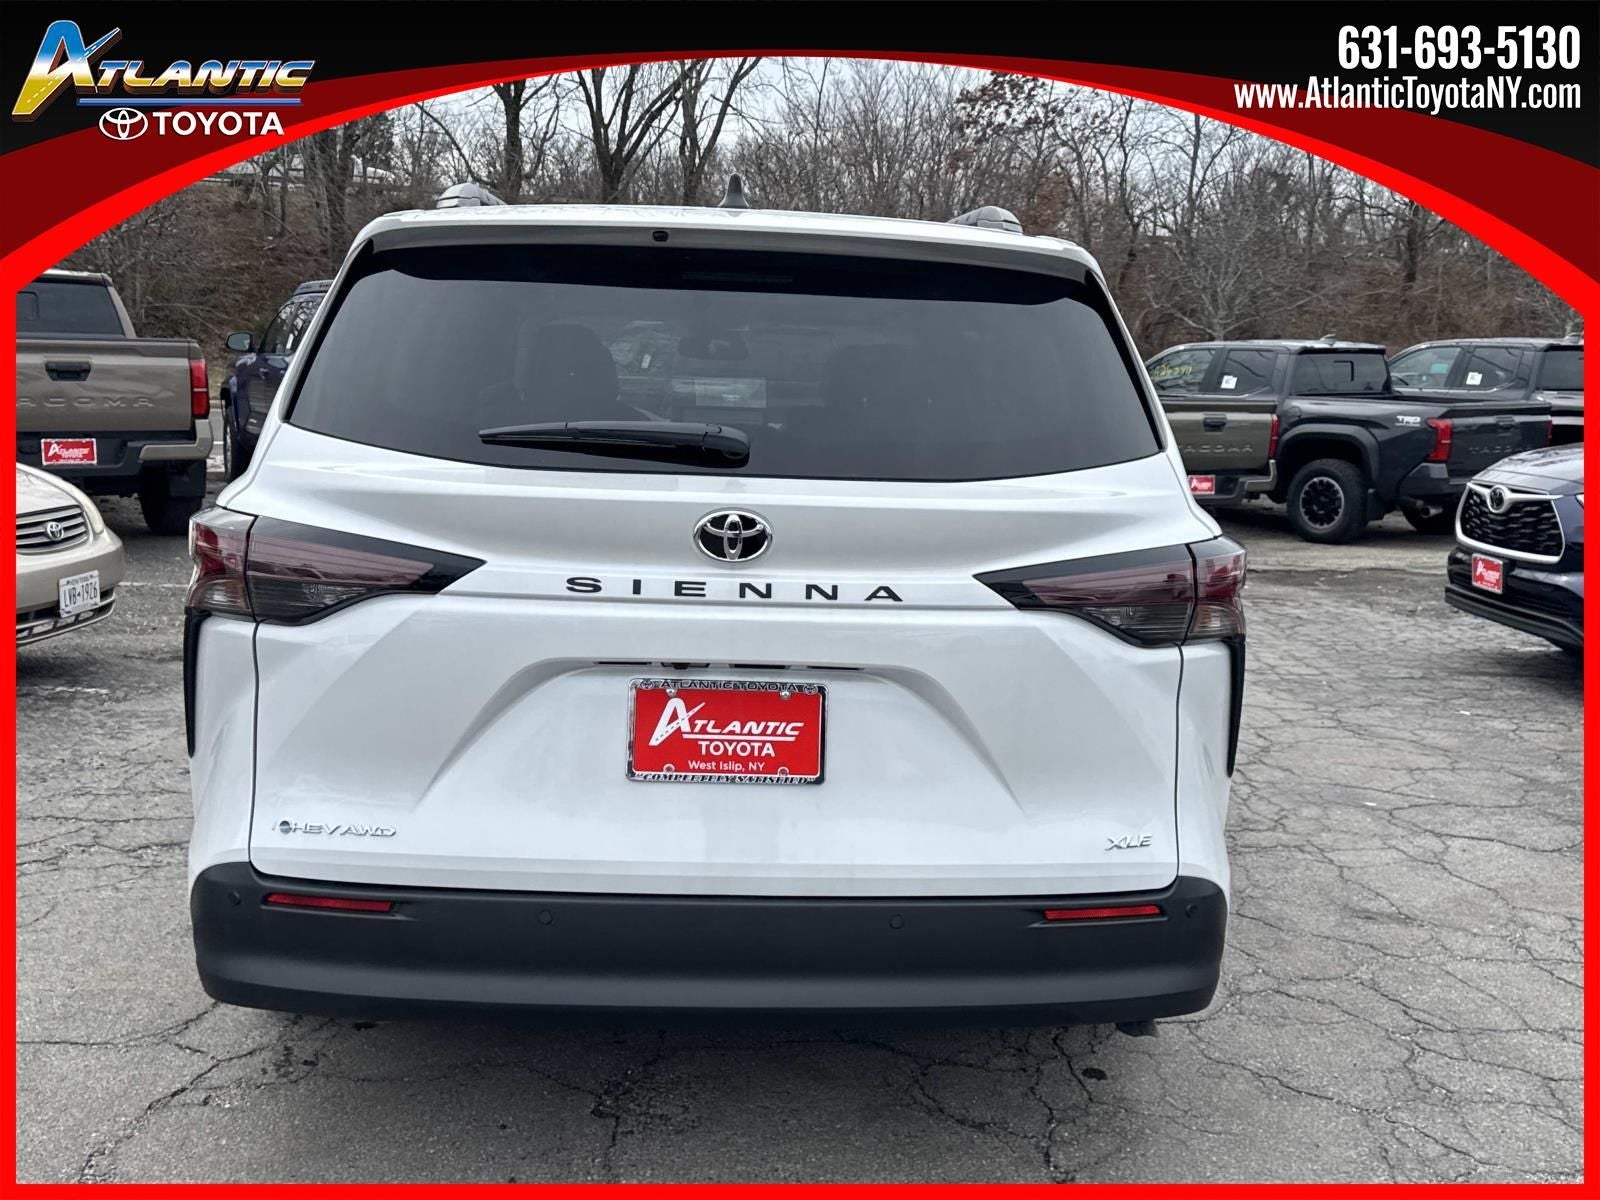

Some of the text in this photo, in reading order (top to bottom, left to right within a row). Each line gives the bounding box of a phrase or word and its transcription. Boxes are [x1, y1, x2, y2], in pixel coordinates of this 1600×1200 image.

[565, 576, 904, 602] SIENNA
[661, 680, 798, 692] ATLANTIC TOYOTA
[648, 697, 805, 746] ATLANTIC
[697, 740, 776, 757] TOYOTA
[688, 760, 766, 772] West Islip, NY
[1103, 834, 1153, 851] XLE
